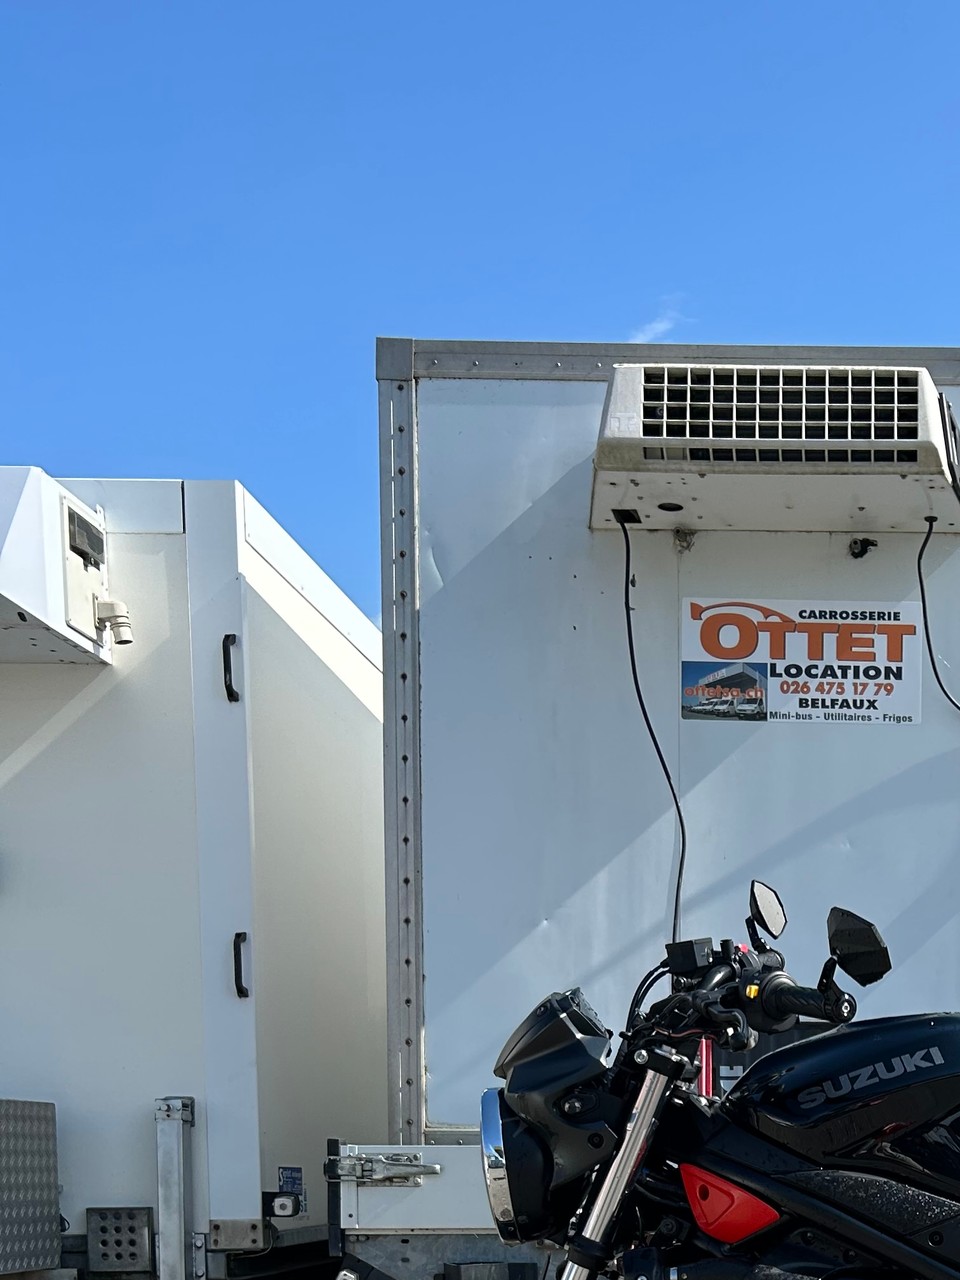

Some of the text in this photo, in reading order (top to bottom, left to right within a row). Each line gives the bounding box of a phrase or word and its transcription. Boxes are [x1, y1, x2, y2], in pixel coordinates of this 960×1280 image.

[798, 609, 901, 622] CARROSSERIE
[700, 612, 917, 663] OTTET
[769, 662, 903, 681] LOCATION
[684, 684, 764, 699] ottetsa.ch
[779, 680, 895, 697] 026 475 17 79
[798, 697, 879, 711] BELFAUX
[769, 711, 813, 721] Mini-bus
[823, 712, 873, 722] Utilitaires
[882, 713, 913, 724] Frigos
[796, 1046, 945, 1110] SUZUKI
